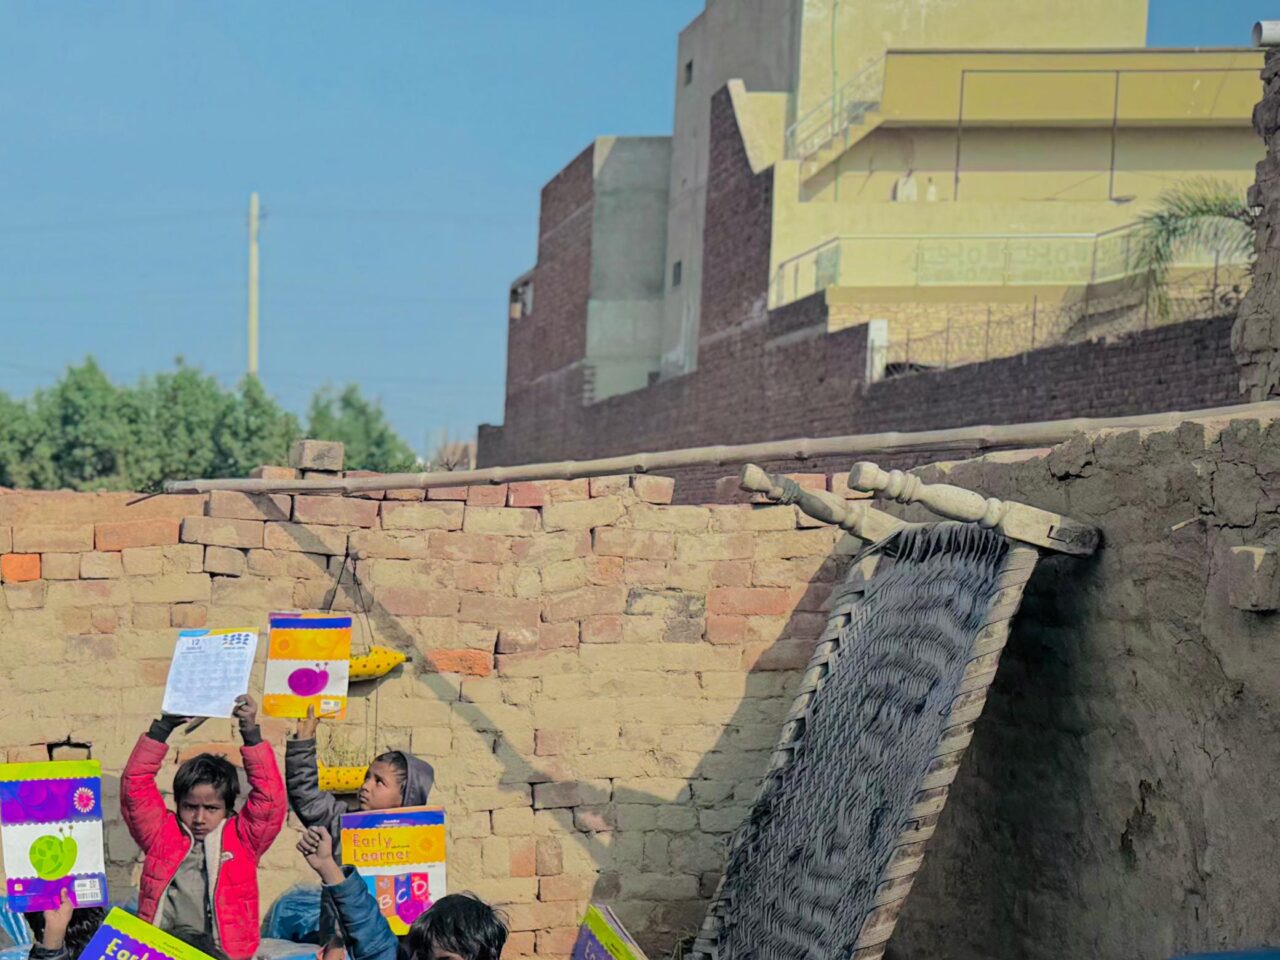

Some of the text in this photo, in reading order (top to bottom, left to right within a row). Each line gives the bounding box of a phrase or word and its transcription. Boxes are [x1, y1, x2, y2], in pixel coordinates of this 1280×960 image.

[352, 833, 392, 849] Early
[352, 849, 411, 862] Learner
[412, 880, 427, 895] D
[379, 894, 392, 909] B
[396, 888, 408, 904] C
